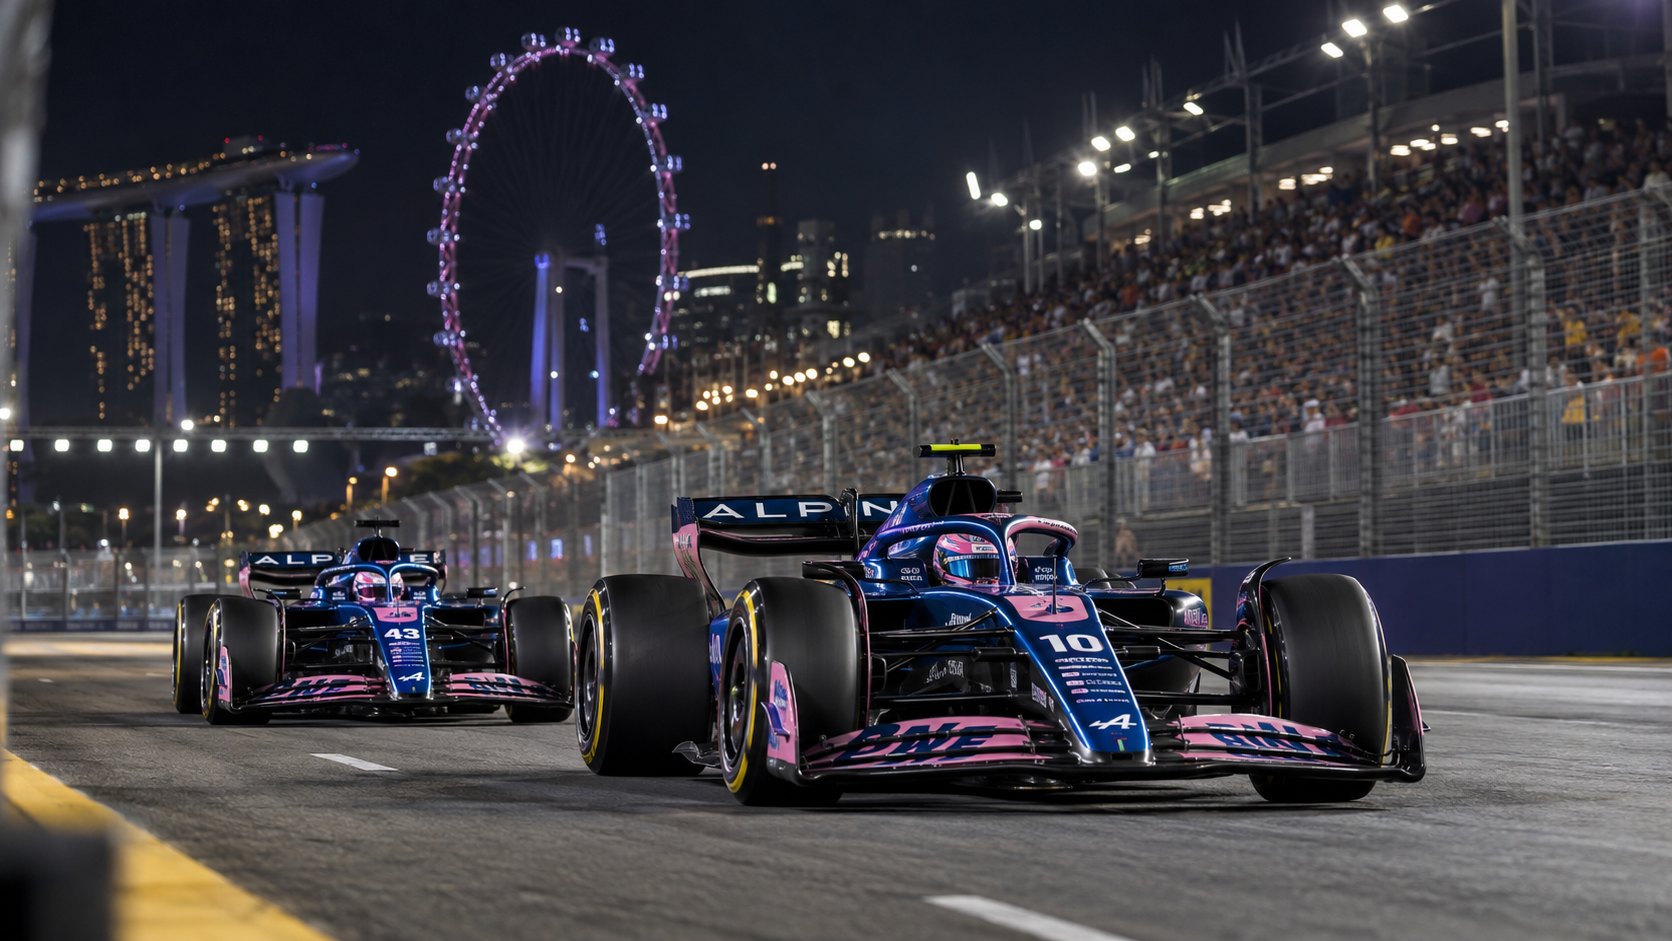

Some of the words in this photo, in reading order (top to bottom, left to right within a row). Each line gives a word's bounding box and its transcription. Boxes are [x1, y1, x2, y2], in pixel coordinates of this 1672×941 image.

[702, 500, 898, 519] ALPN
[254, 553, 430, 566] ALPE
[384, 628, 420, 640] 43
[1039, 634, 1104, 653] 10
